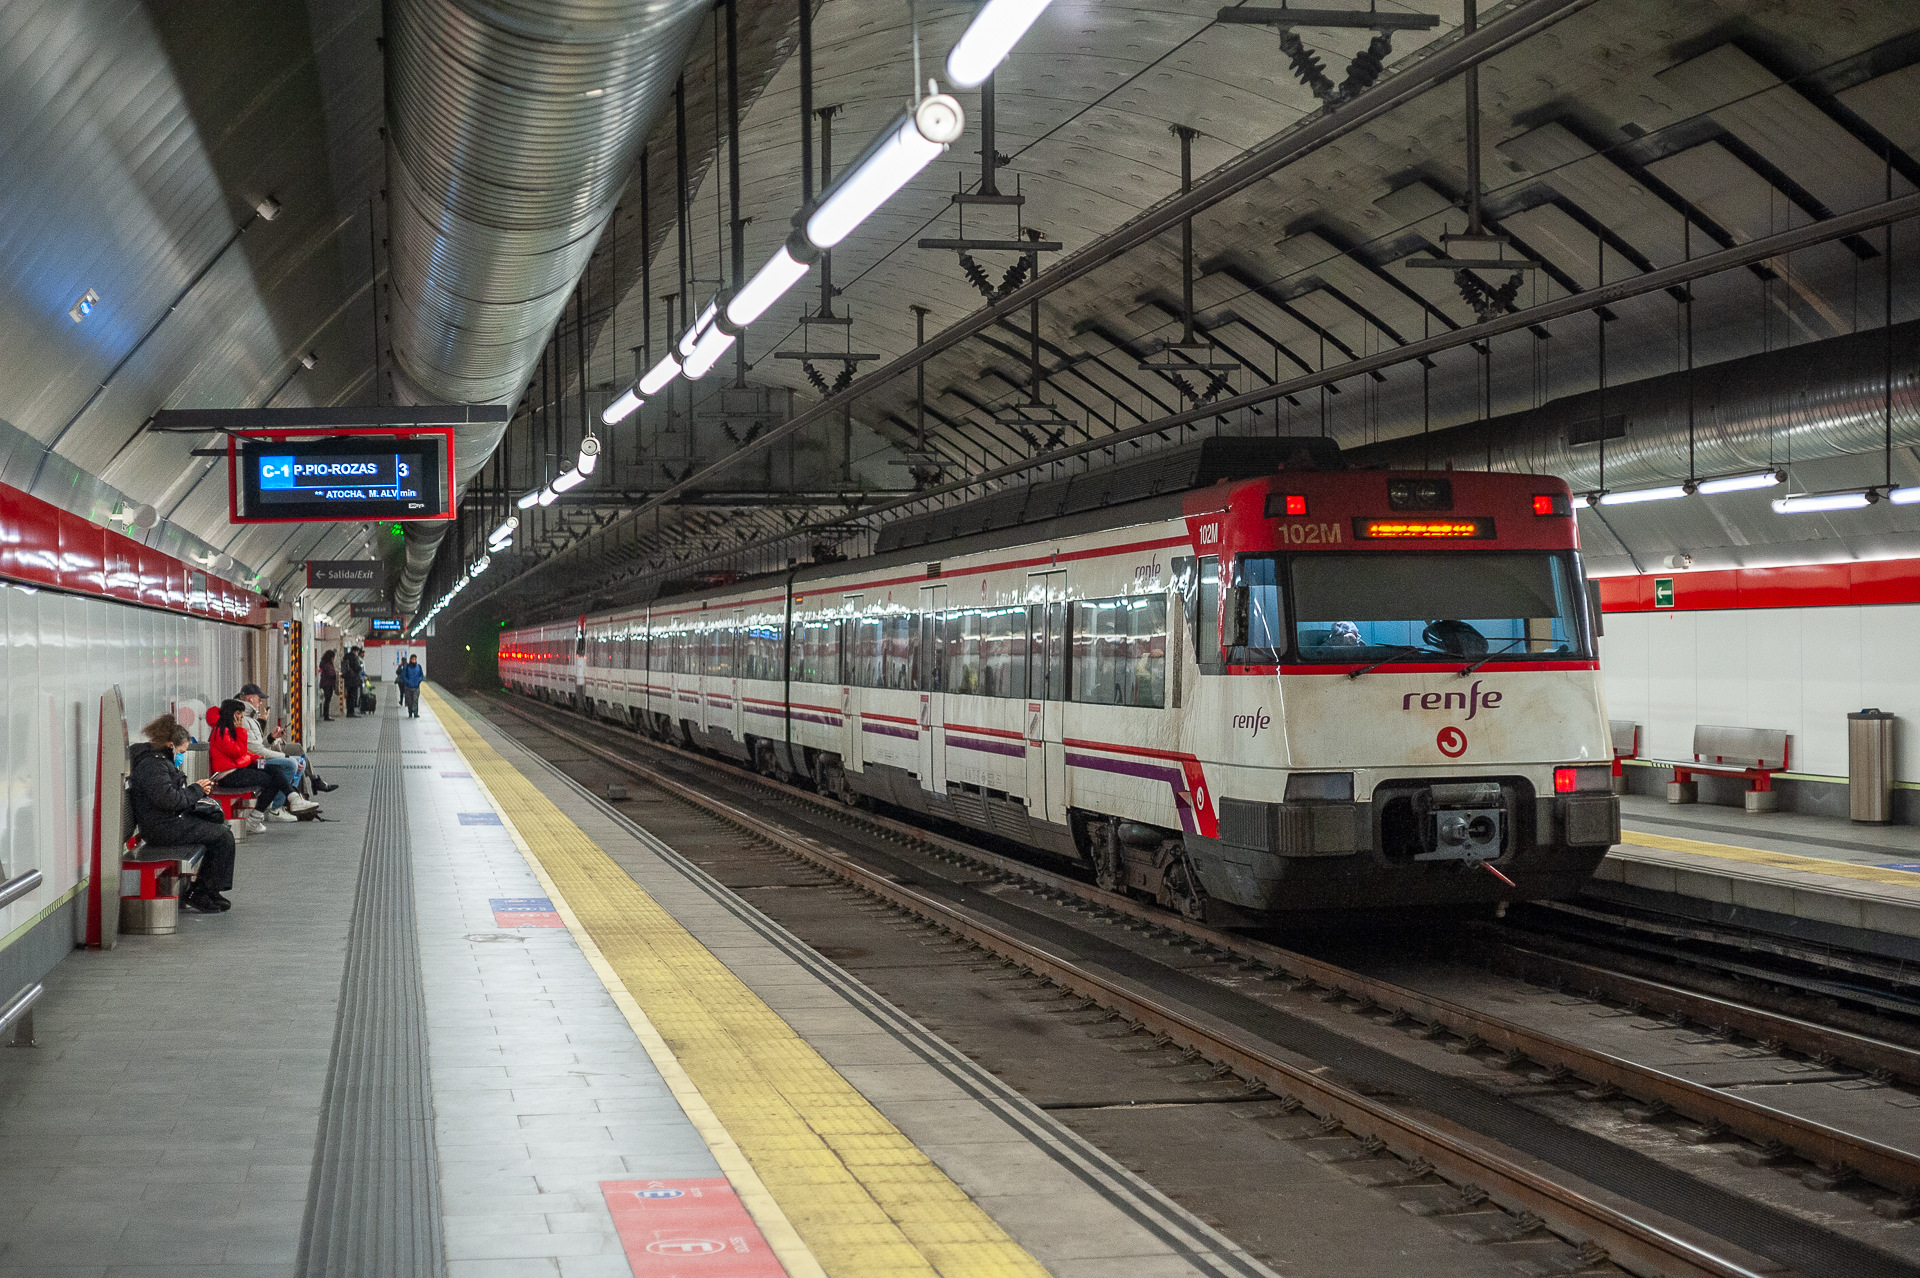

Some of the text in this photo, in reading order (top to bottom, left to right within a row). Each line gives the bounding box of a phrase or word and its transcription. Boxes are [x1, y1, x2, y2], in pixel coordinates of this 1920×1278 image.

[262, 463, 410, 478] C-1 P.PIO-ROZAS 3
[326, 490, 366, 499] ATOCHA,
[400, 489, 417, 498] min
[1199, 523, 1219, 545] 102M
[1278, 523, 1342, 544] 102M
[328, 570, 374, 579] Salida/Exit
[1134, 553, 1161, 580] renfe
[1402, 679, 1503, 721] renfe
[1232, 706, 1271, 738] renfe
